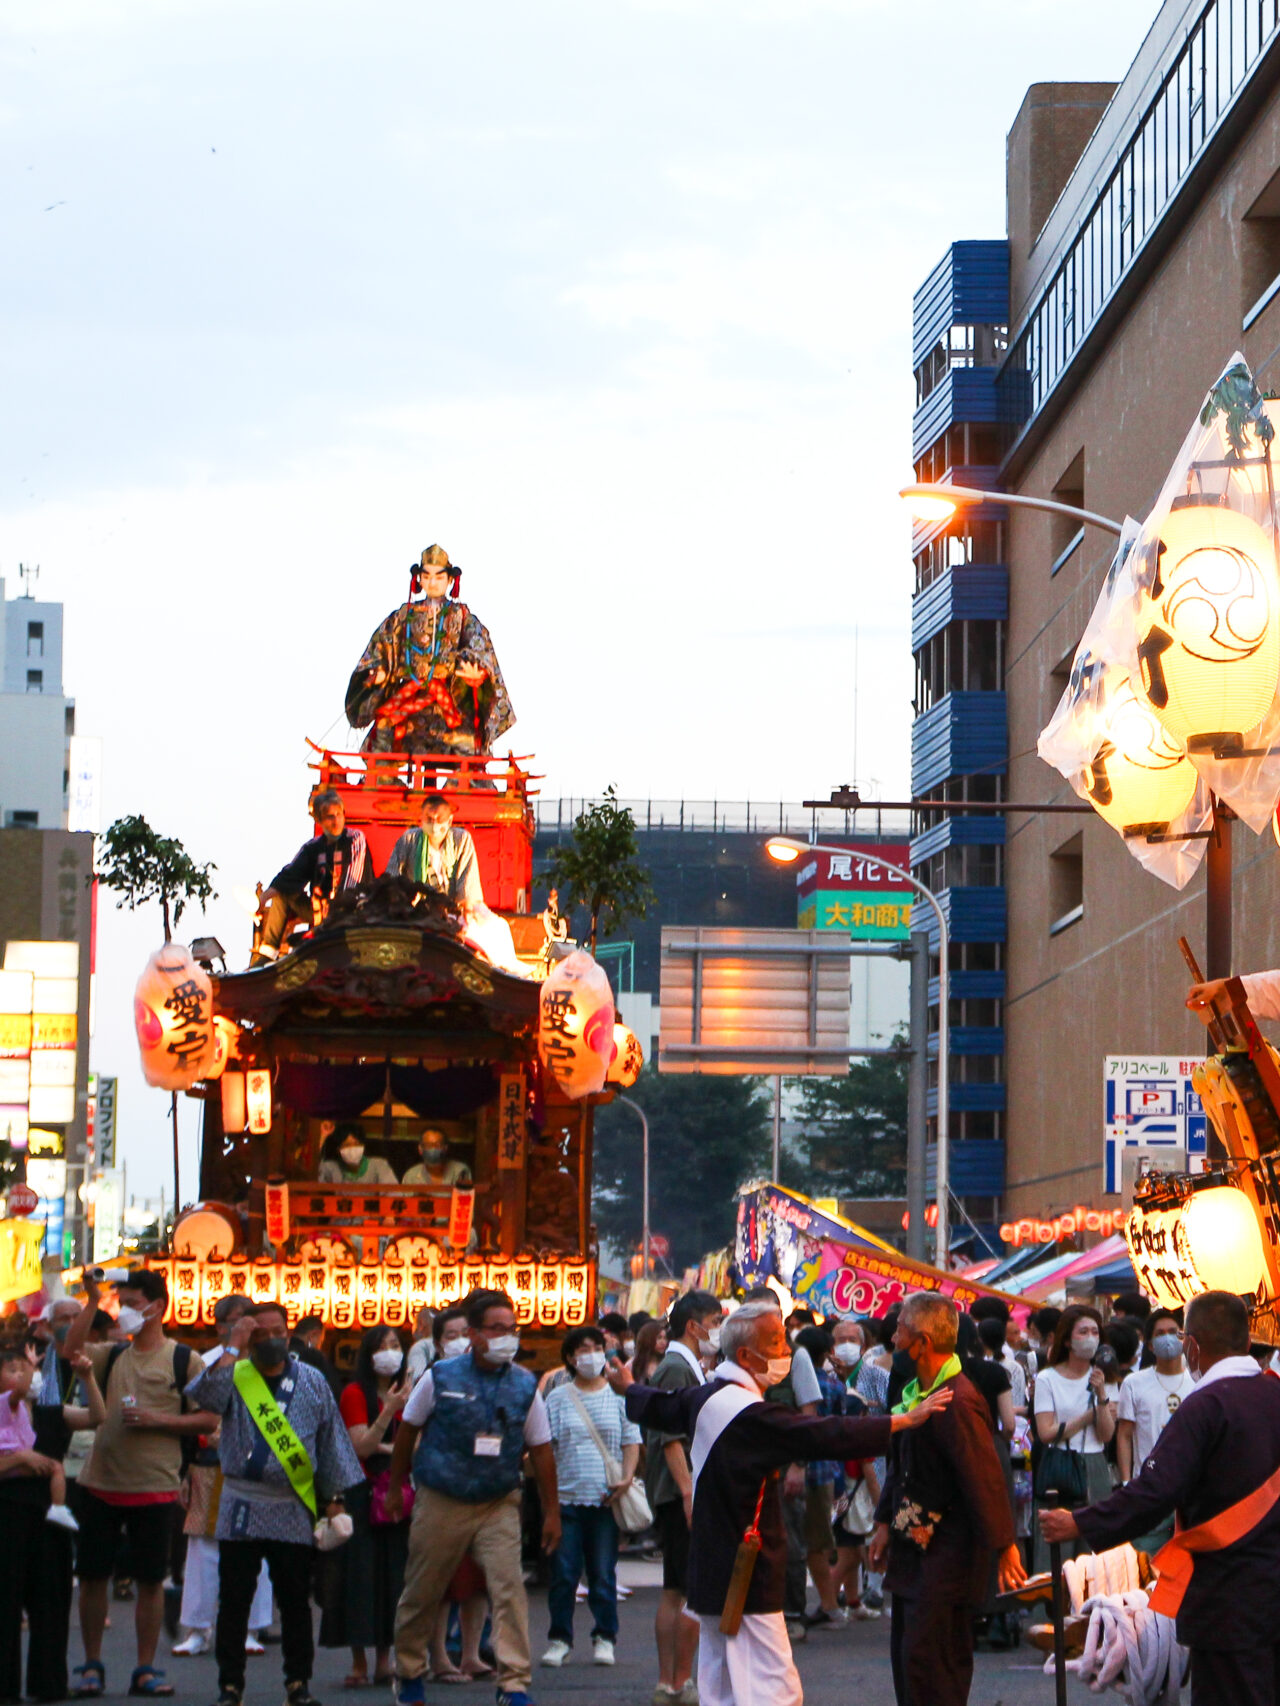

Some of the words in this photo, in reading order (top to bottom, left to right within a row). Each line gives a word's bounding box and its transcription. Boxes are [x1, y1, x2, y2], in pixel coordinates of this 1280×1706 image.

[828, 855, 913, 882] 尾花ビ
[1110, 1062, 1169, 1075] アリコベール
[1143, 1092, 1160, 1106] P
[1194, 1129, 1205, 1138] JR
[256, 1402, 306, 1472] 本部役員
